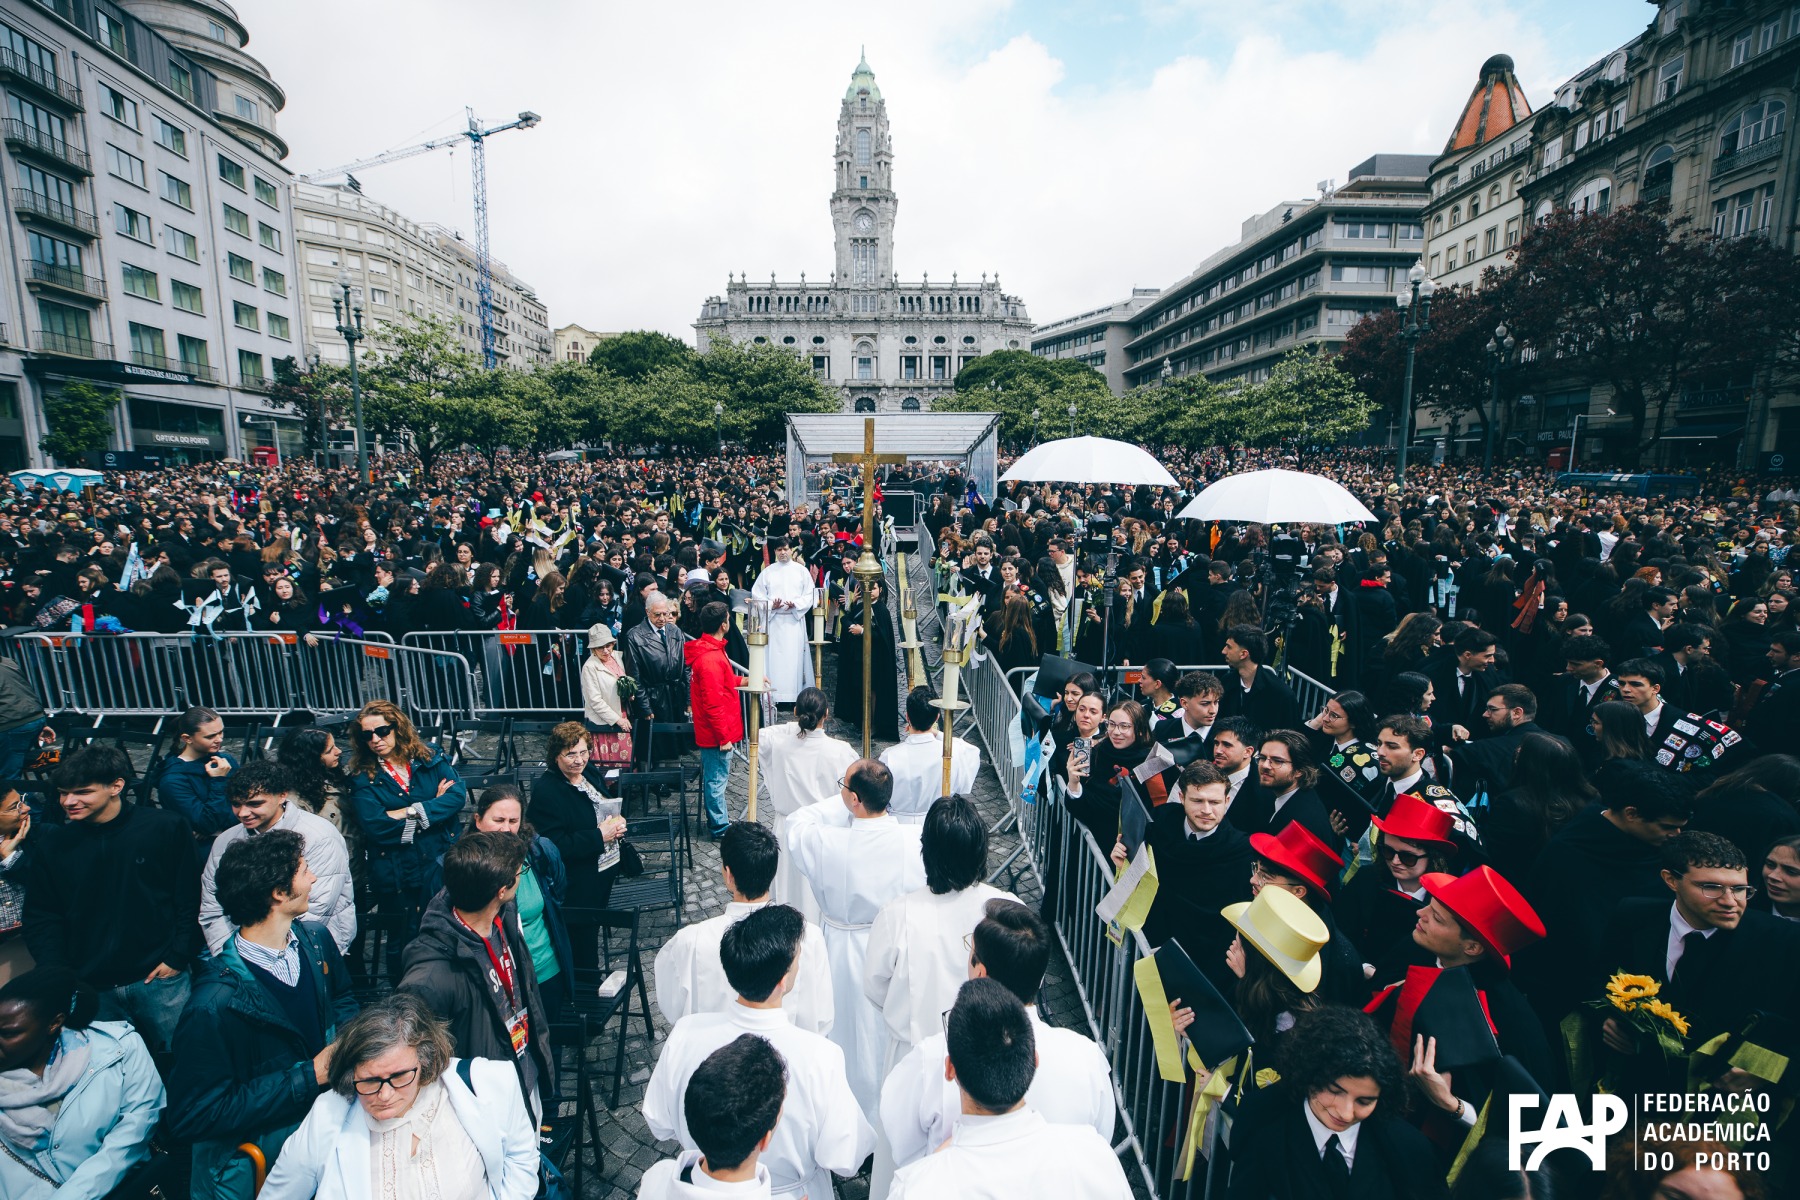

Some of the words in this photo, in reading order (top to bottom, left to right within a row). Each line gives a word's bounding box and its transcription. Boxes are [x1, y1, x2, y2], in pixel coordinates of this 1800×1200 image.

[131, 366, 164, 379] EUROSTARS
[165, 372, 189, 382] ALIADOS
[180, 436, 189, 444] DO
[190, 437, 210, 445] PORTO
[1537, 431, 1555, 441] HOTEL
